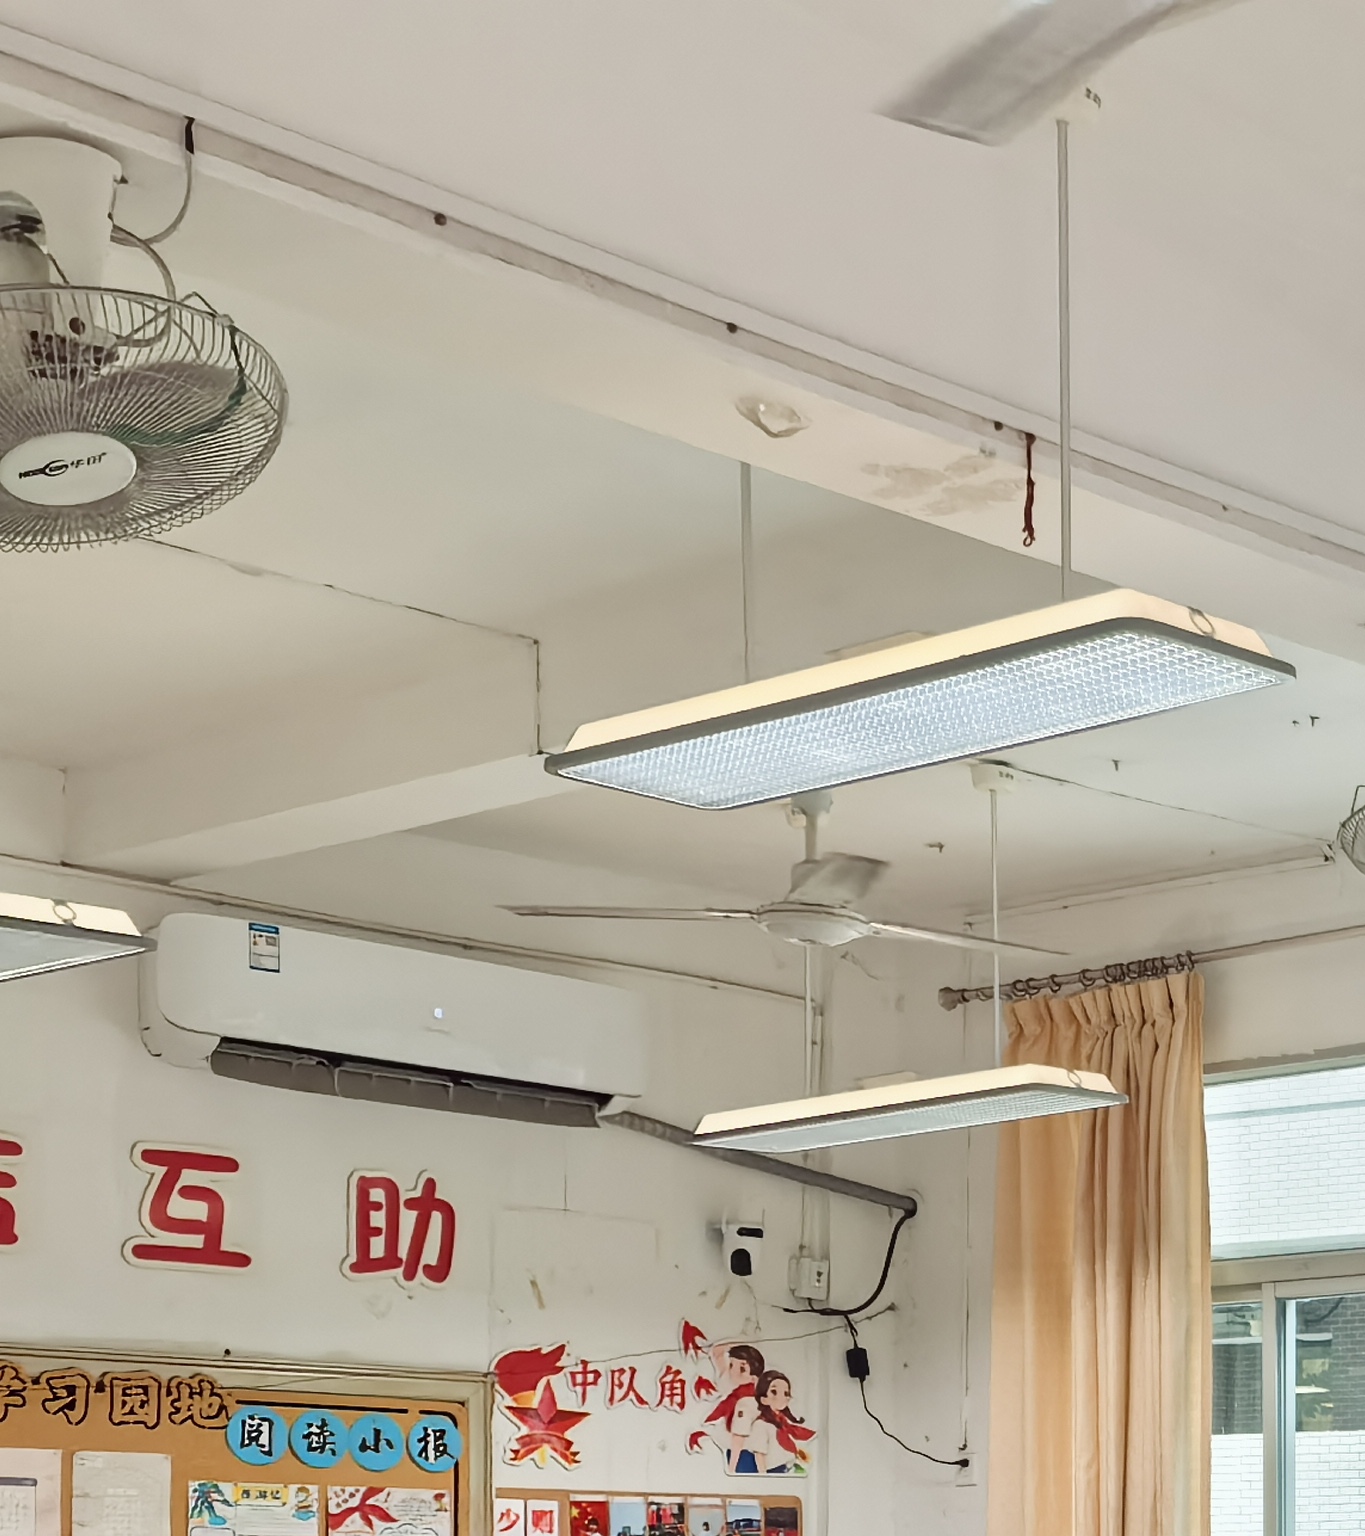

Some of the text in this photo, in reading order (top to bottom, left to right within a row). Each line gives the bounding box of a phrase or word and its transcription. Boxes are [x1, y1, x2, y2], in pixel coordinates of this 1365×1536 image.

[568, 1360, 688, 1412] 中队角
[240, 1415, 457, 1464] 阅读小报
